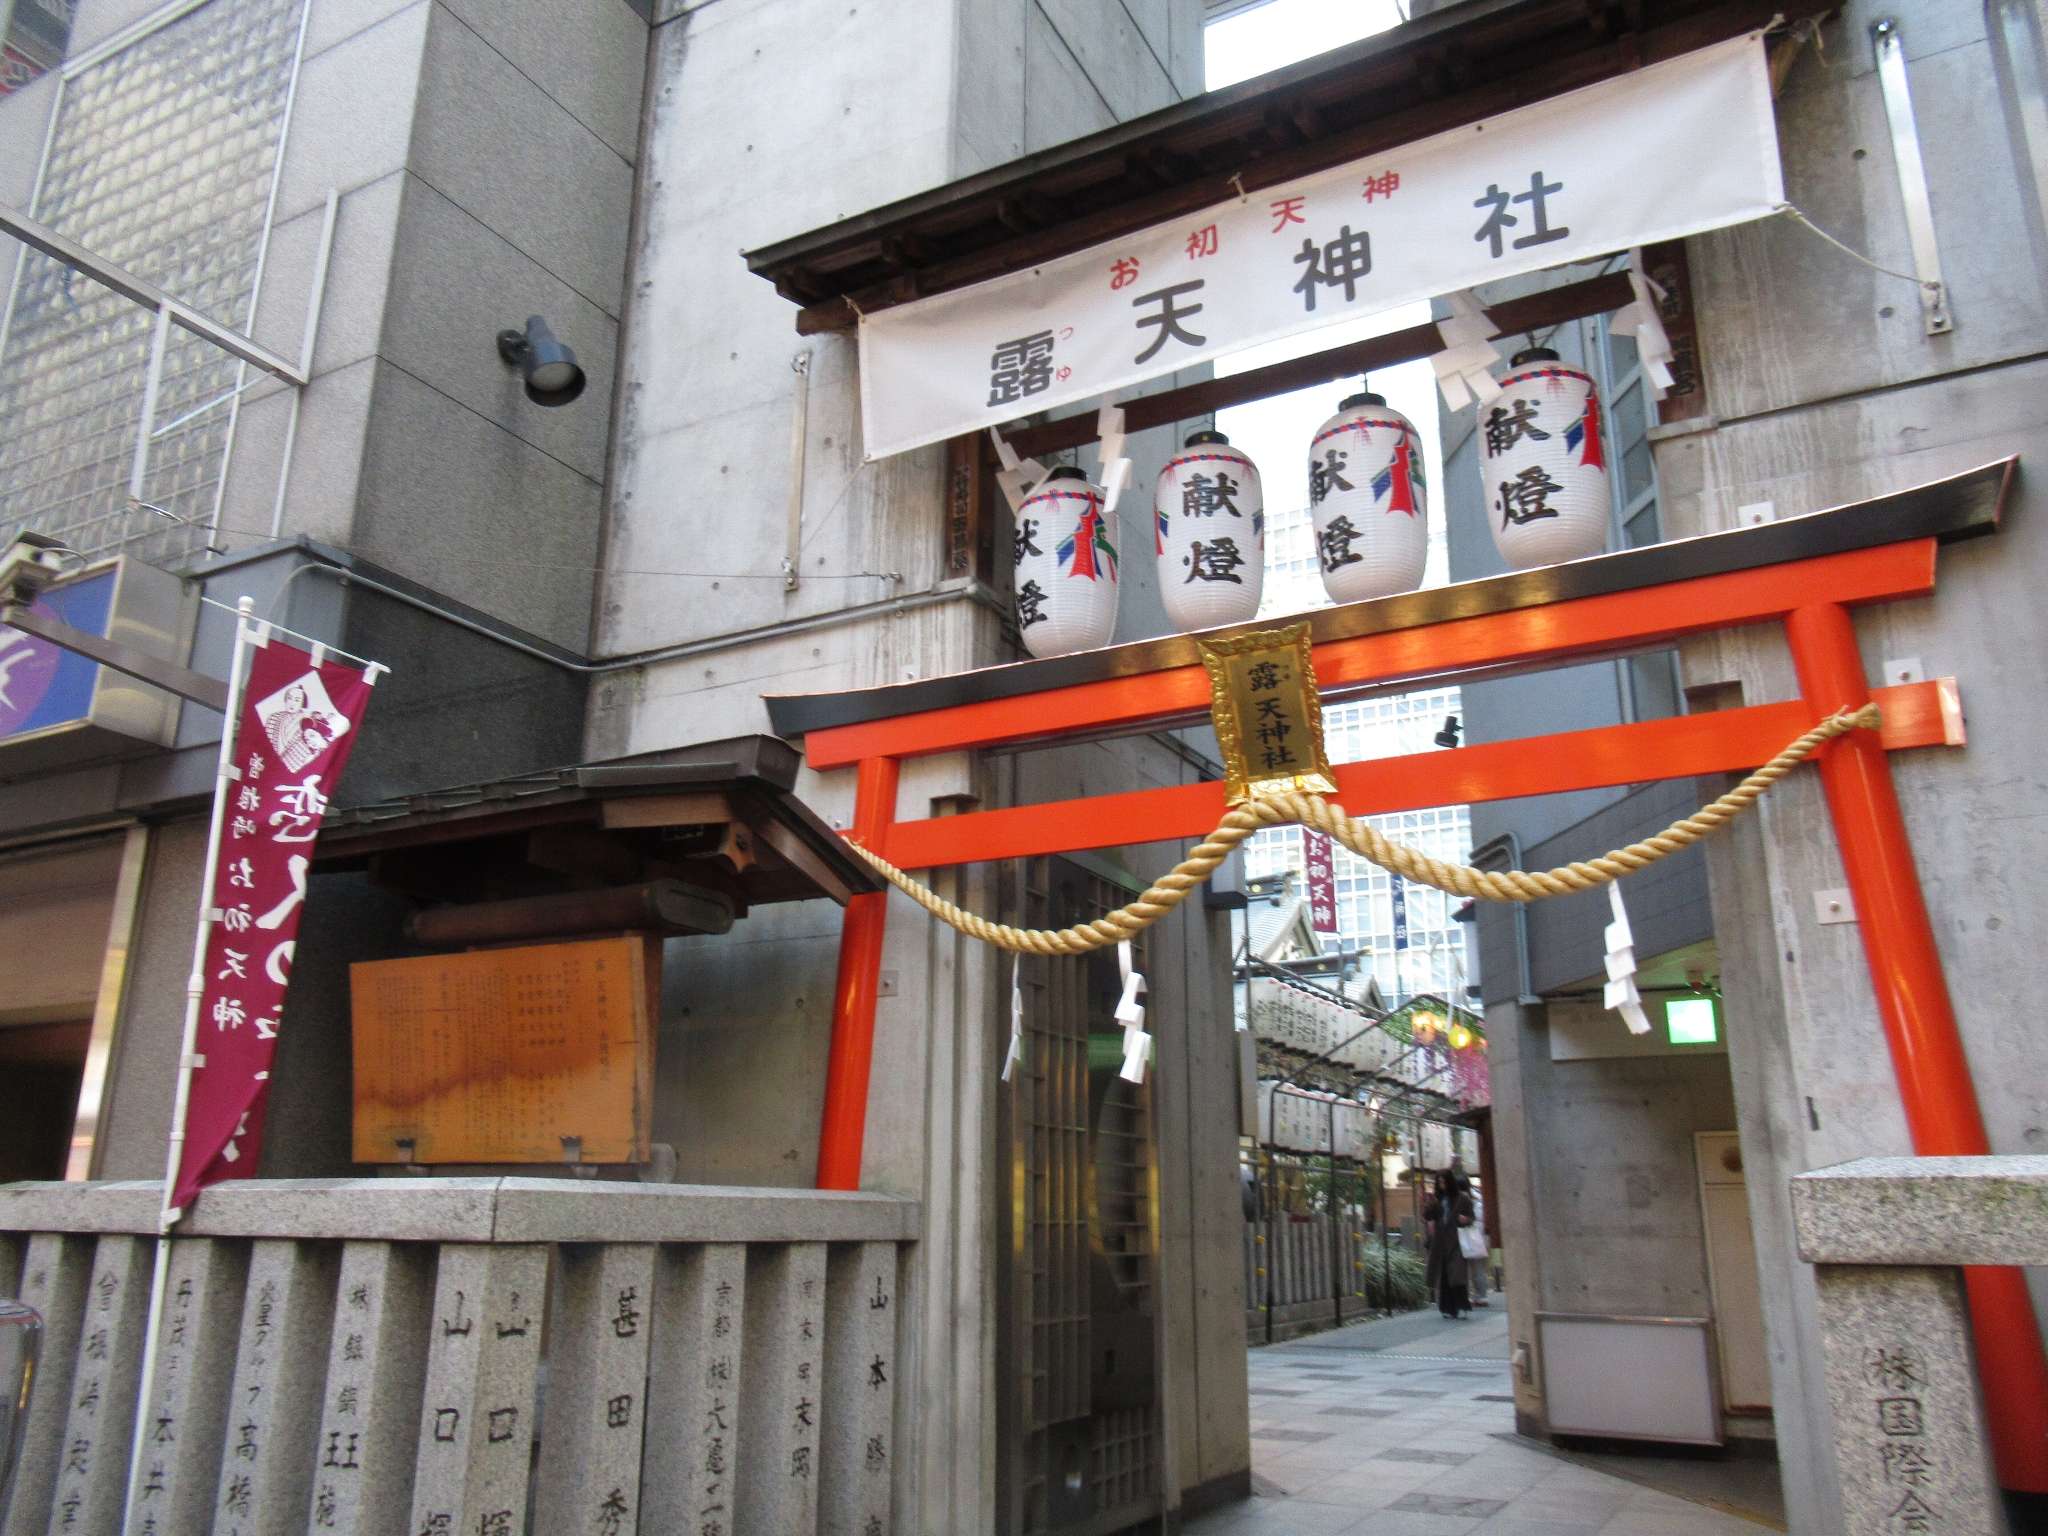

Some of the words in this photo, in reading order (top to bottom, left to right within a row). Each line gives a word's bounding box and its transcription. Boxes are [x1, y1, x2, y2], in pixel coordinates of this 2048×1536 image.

[986, 170, 1570, 408] 露天神社
[1110, 169, 1402, 292] お初天神
[1309, 448, 1365, 573] 献燈
[1484, 398, 1565, 531] 献燈
[1181, 471, 1246, 585] 献燈
[1248, 661, 1297, 770] 露天神社
[1308, 838, 1332, 925] お初天神
